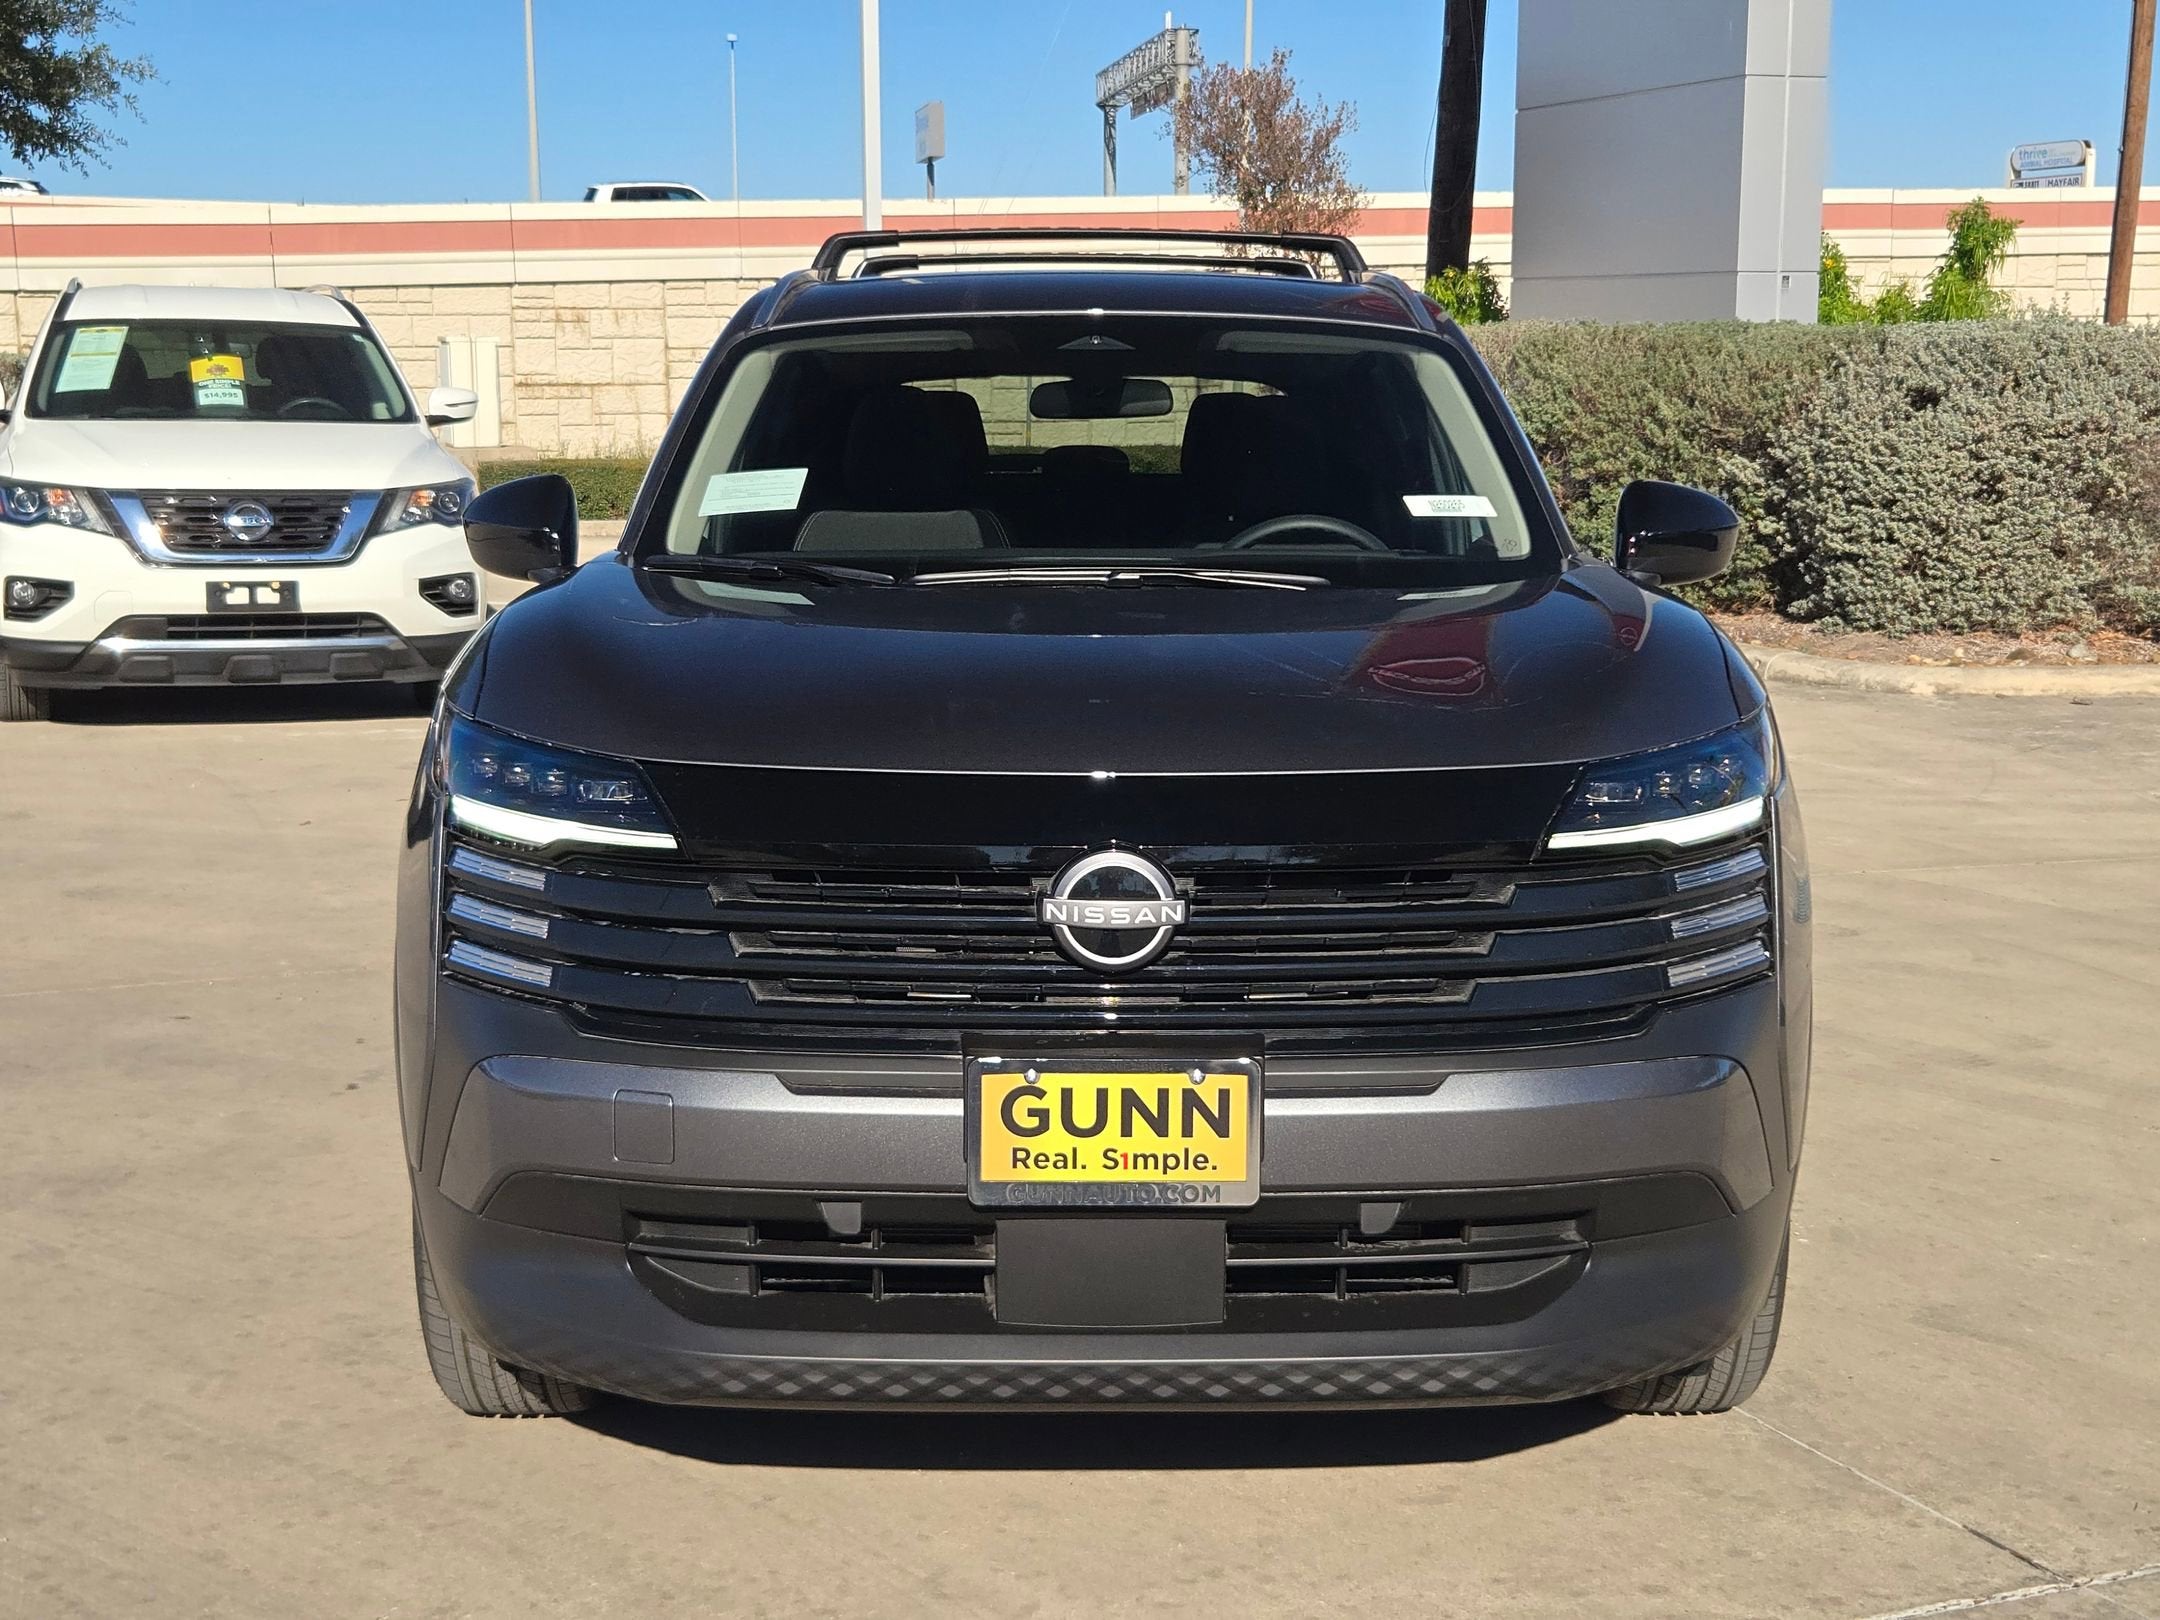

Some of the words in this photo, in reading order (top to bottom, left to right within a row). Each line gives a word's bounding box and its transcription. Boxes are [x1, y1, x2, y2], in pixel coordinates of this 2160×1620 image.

[2019, 147, 2048, 160] thrive
[2047, 177, 2080, 188] MAYFAIR
[1045, 902, 1182, 924] NISSAN
[1000, 1085, 1231, 1138] GUNN
[1011, 1147, 1087, 1170] Real.
[1006, 1182, 1222, 1204] GUNNAUTO.COM
